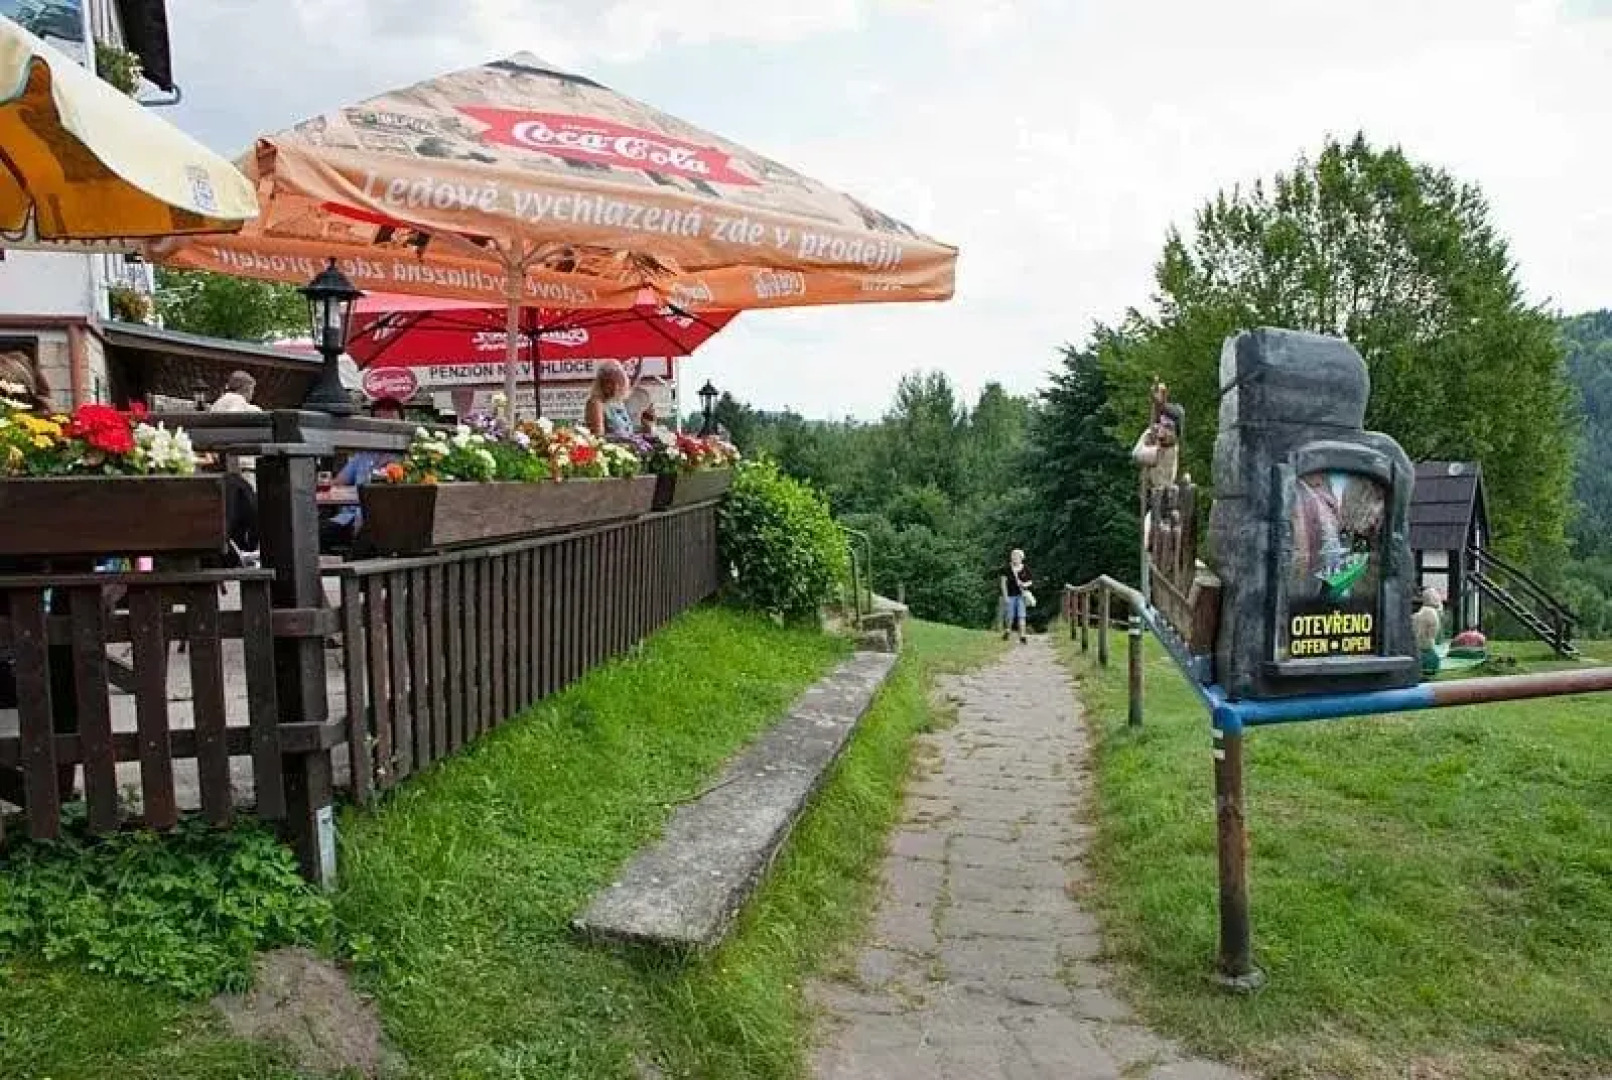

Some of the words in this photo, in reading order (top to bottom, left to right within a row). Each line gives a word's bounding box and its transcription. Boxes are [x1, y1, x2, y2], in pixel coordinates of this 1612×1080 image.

[512, 188, 701, 237] vychlazená
[711, 215, 765, 245] zde
[774, 227, 791, 248] v
[430, 365, 493, 379] PENZION
[1292, 610, 1373, 635] OTEVŘENO
[1291, 639, 1329, 654] OFFEN
[1341, 637, 1371, 652] OPEN
